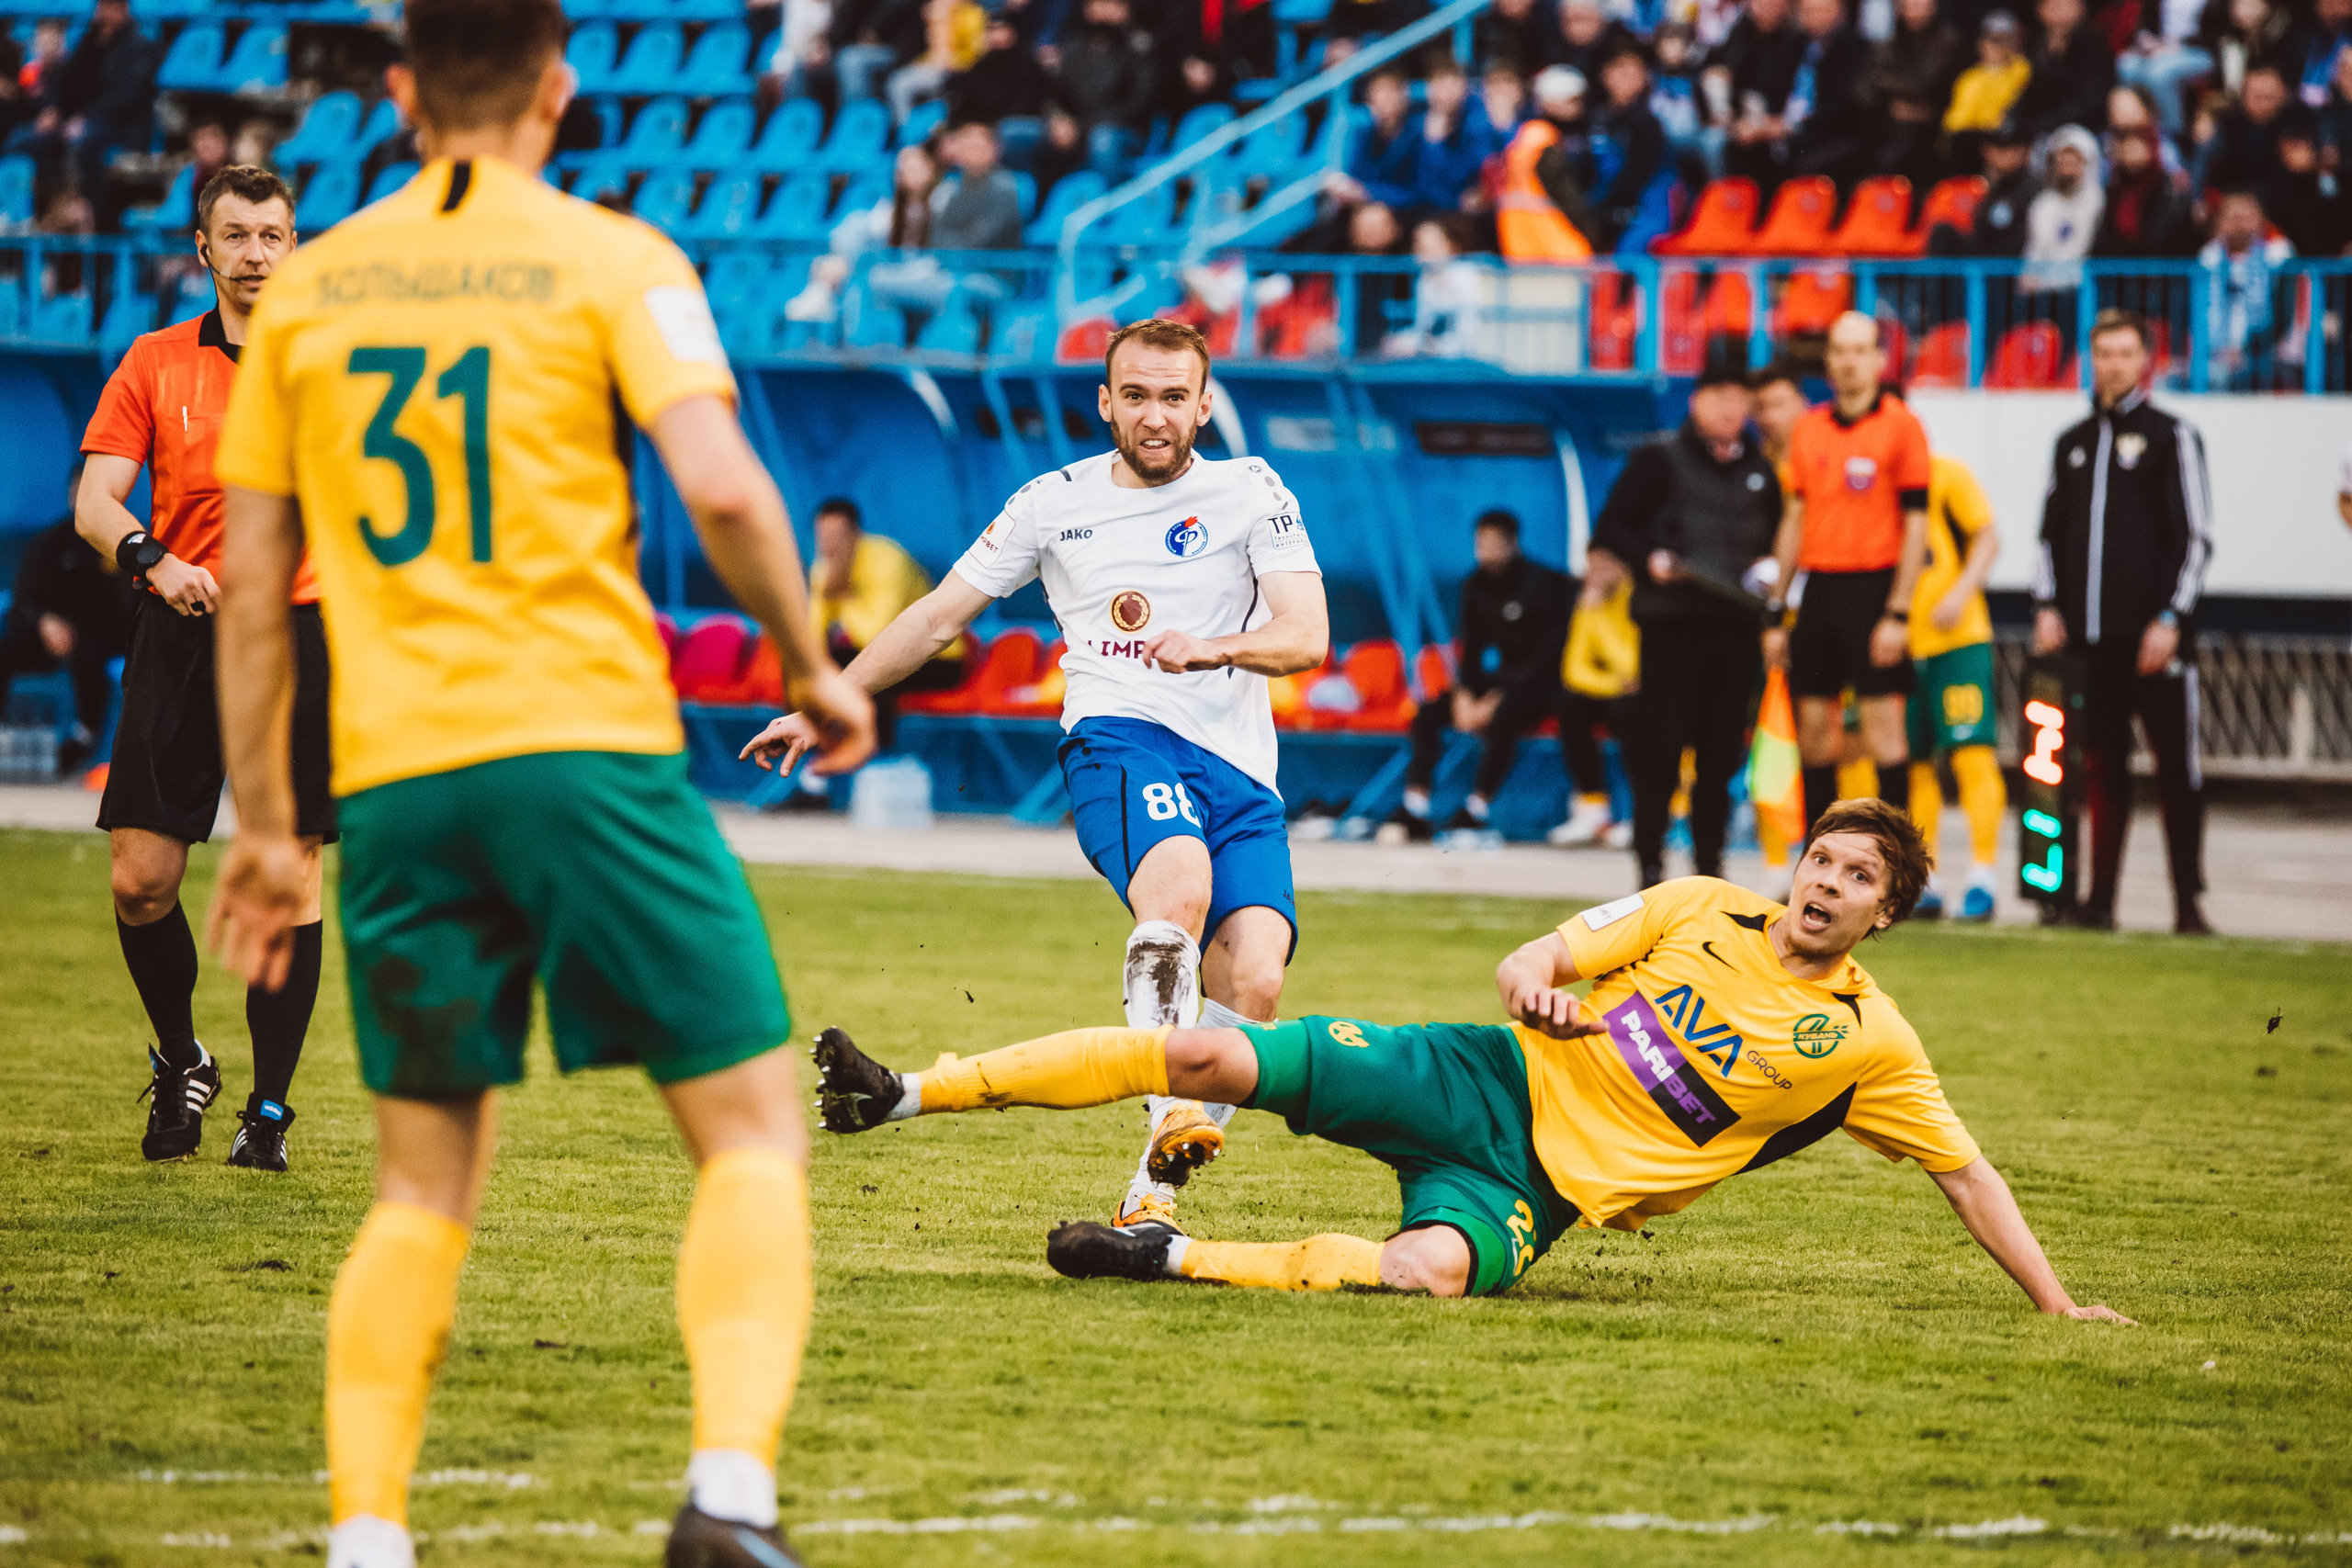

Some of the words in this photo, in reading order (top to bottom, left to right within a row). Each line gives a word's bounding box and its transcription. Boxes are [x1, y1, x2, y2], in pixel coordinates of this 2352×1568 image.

[348, 347, 492, 566] 31
[1060, 529, 1093, 541] JAKO
[1621, 1010, 1716, 1125] PARIBET
[1655, 984, 1744, 1078] AVA
[1747, 1050, 1792, 1089] GROUP
